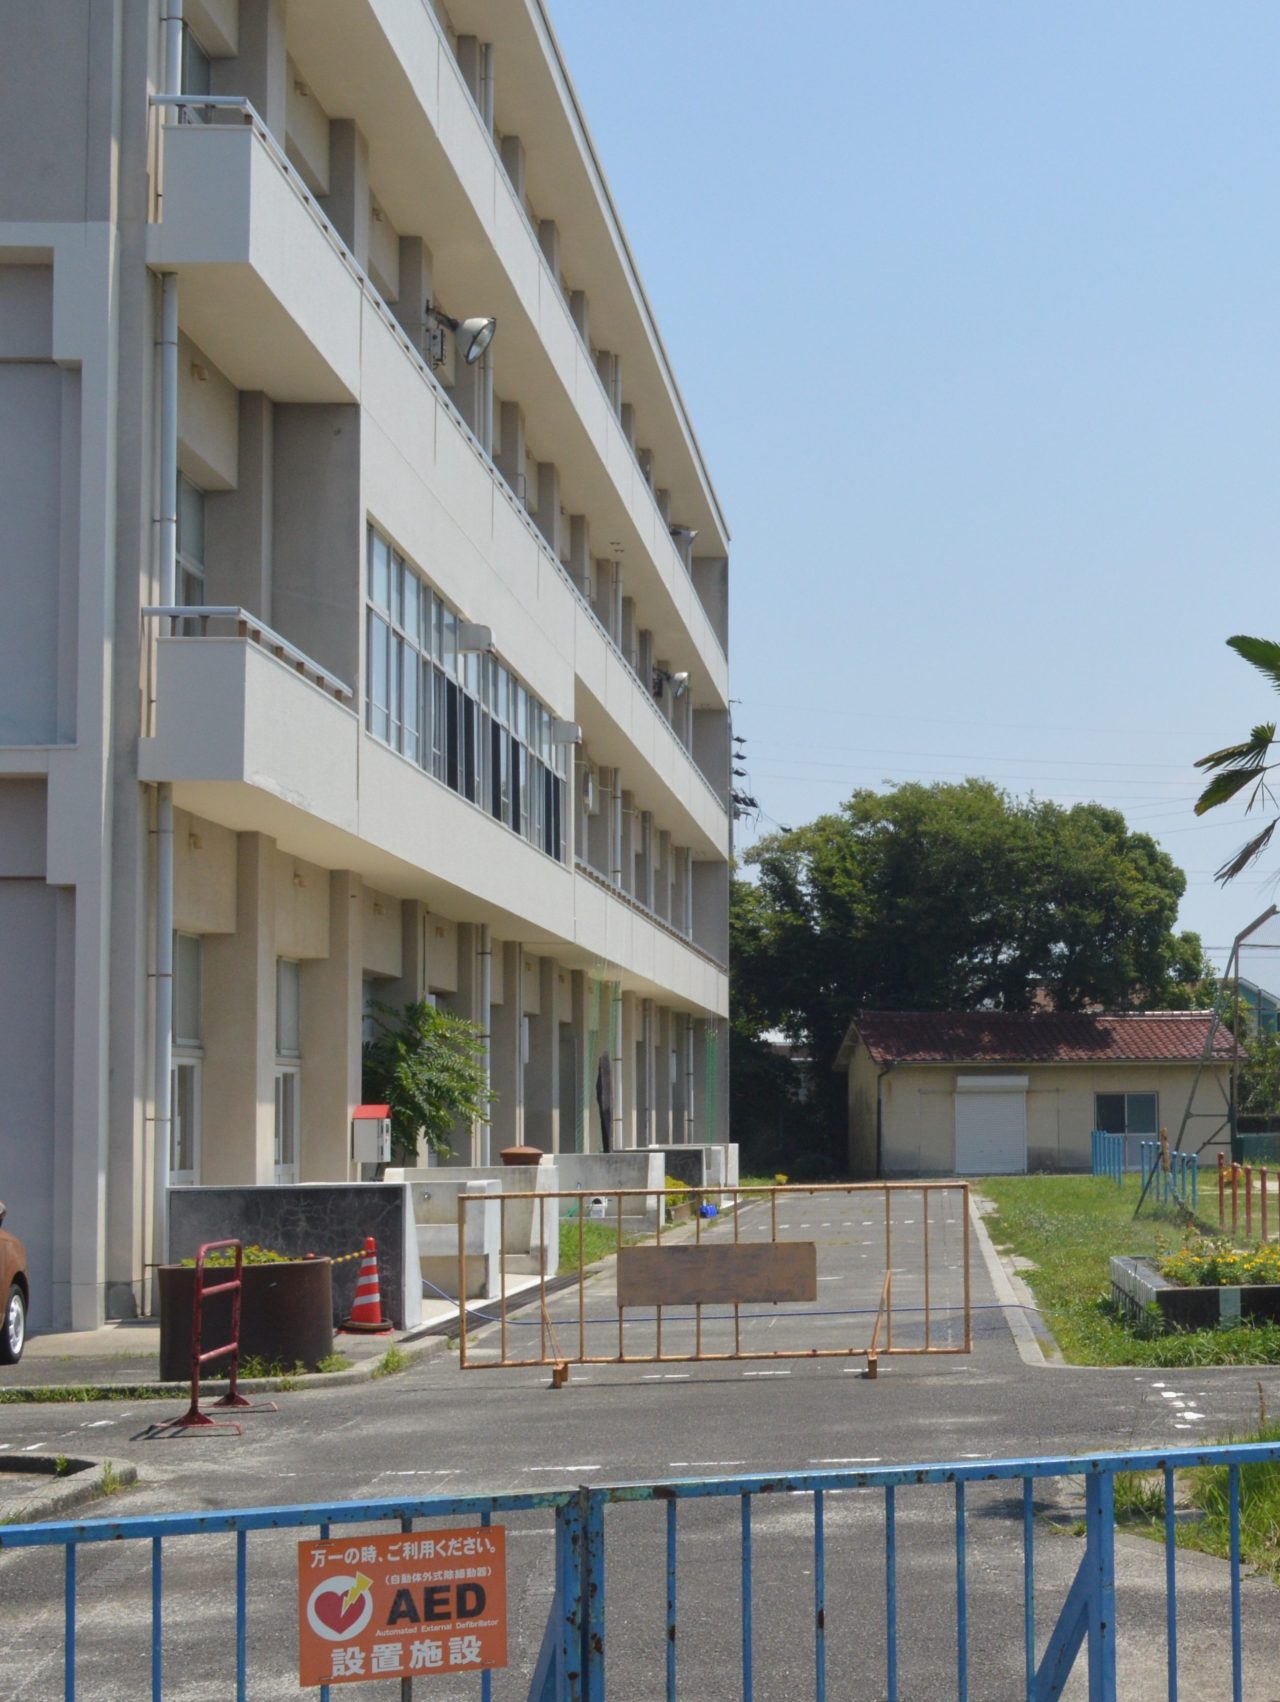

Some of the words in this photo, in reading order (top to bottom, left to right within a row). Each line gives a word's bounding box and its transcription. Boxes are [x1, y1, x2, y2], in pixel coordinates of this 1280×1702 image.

[310, 1536, 496, 1568] 万一の時、ご利用ください。
[386, 1582, 487, 1626] AED
[376, 1626, 418, 1637] Automated
[421, 1623, 453, 1633] External
[331, 1635, 482, 1677] 設置施設
